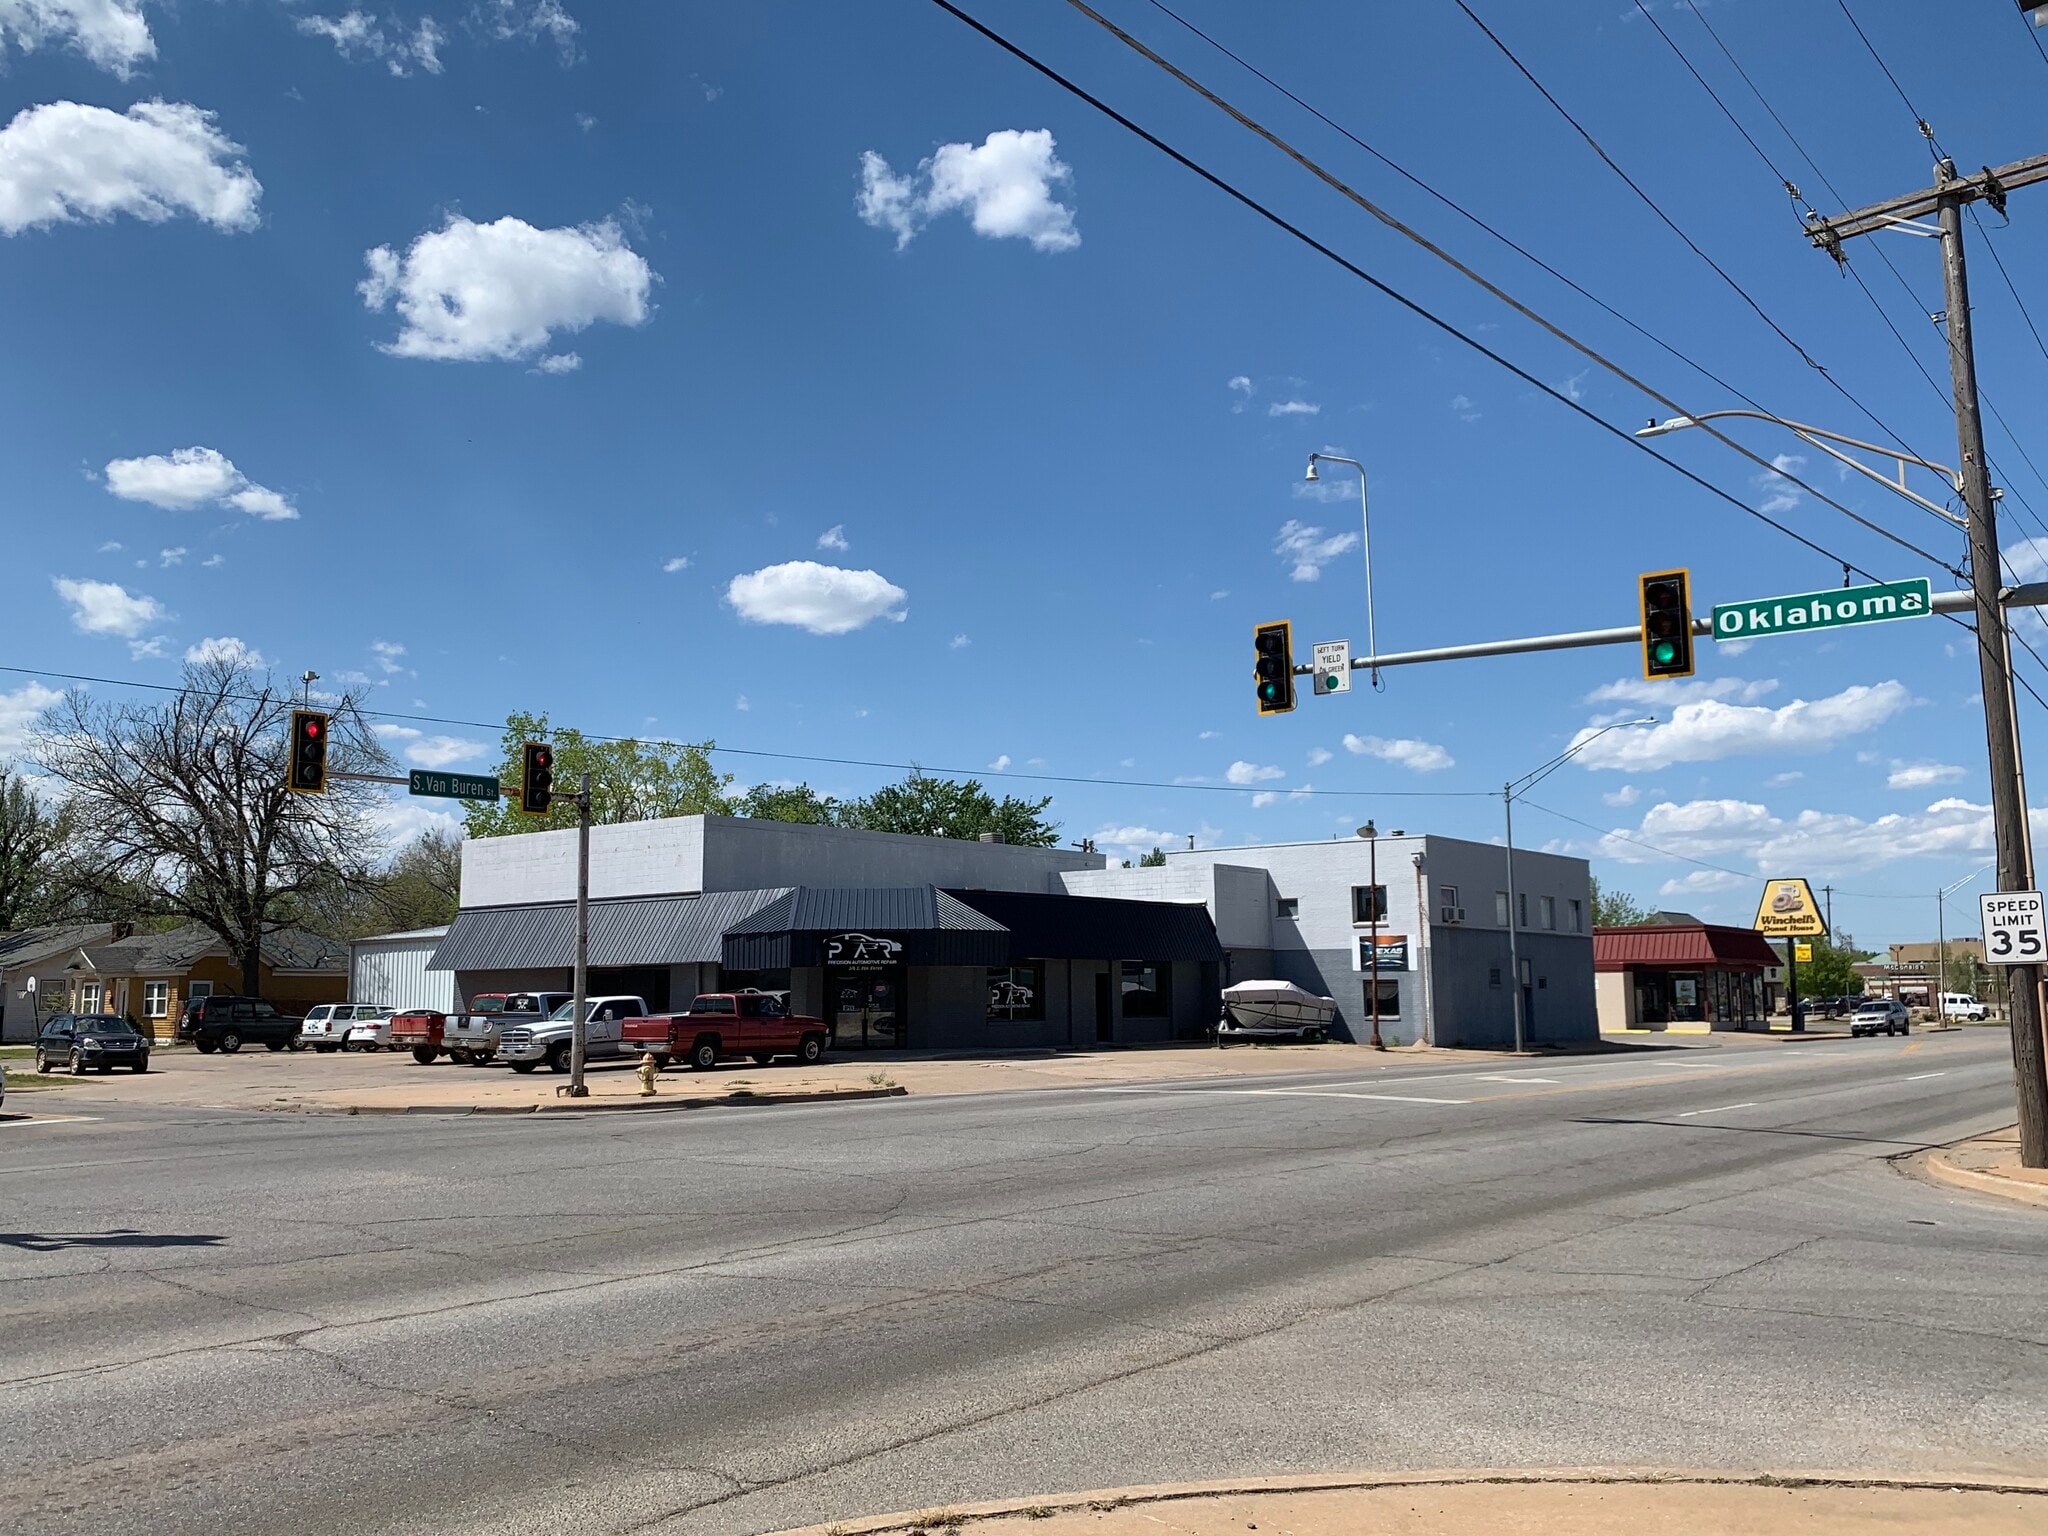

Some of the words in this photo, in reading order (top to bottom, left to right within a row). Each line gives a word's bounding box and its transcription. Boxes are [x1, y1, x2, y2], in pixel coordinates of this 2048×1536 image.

[1719, 592, 1923, 633] Oklahoma
[1317, 646, 1329, 654] LEFT
[1321, 654, 1341, 663] YIELD
[413, 774, 425, 791] S.
[426, 775, 446, 793] Van
[451, 778, 484, 796] Buren
[486, 788, 497, 797] St.
[1987, 900, 2039, 913] SPEED
[1761, 914, 1816, 925] Winchell's
[1992, 914, 2033, 926] LIMIT
[1991, 929, 2042, 955] 35
